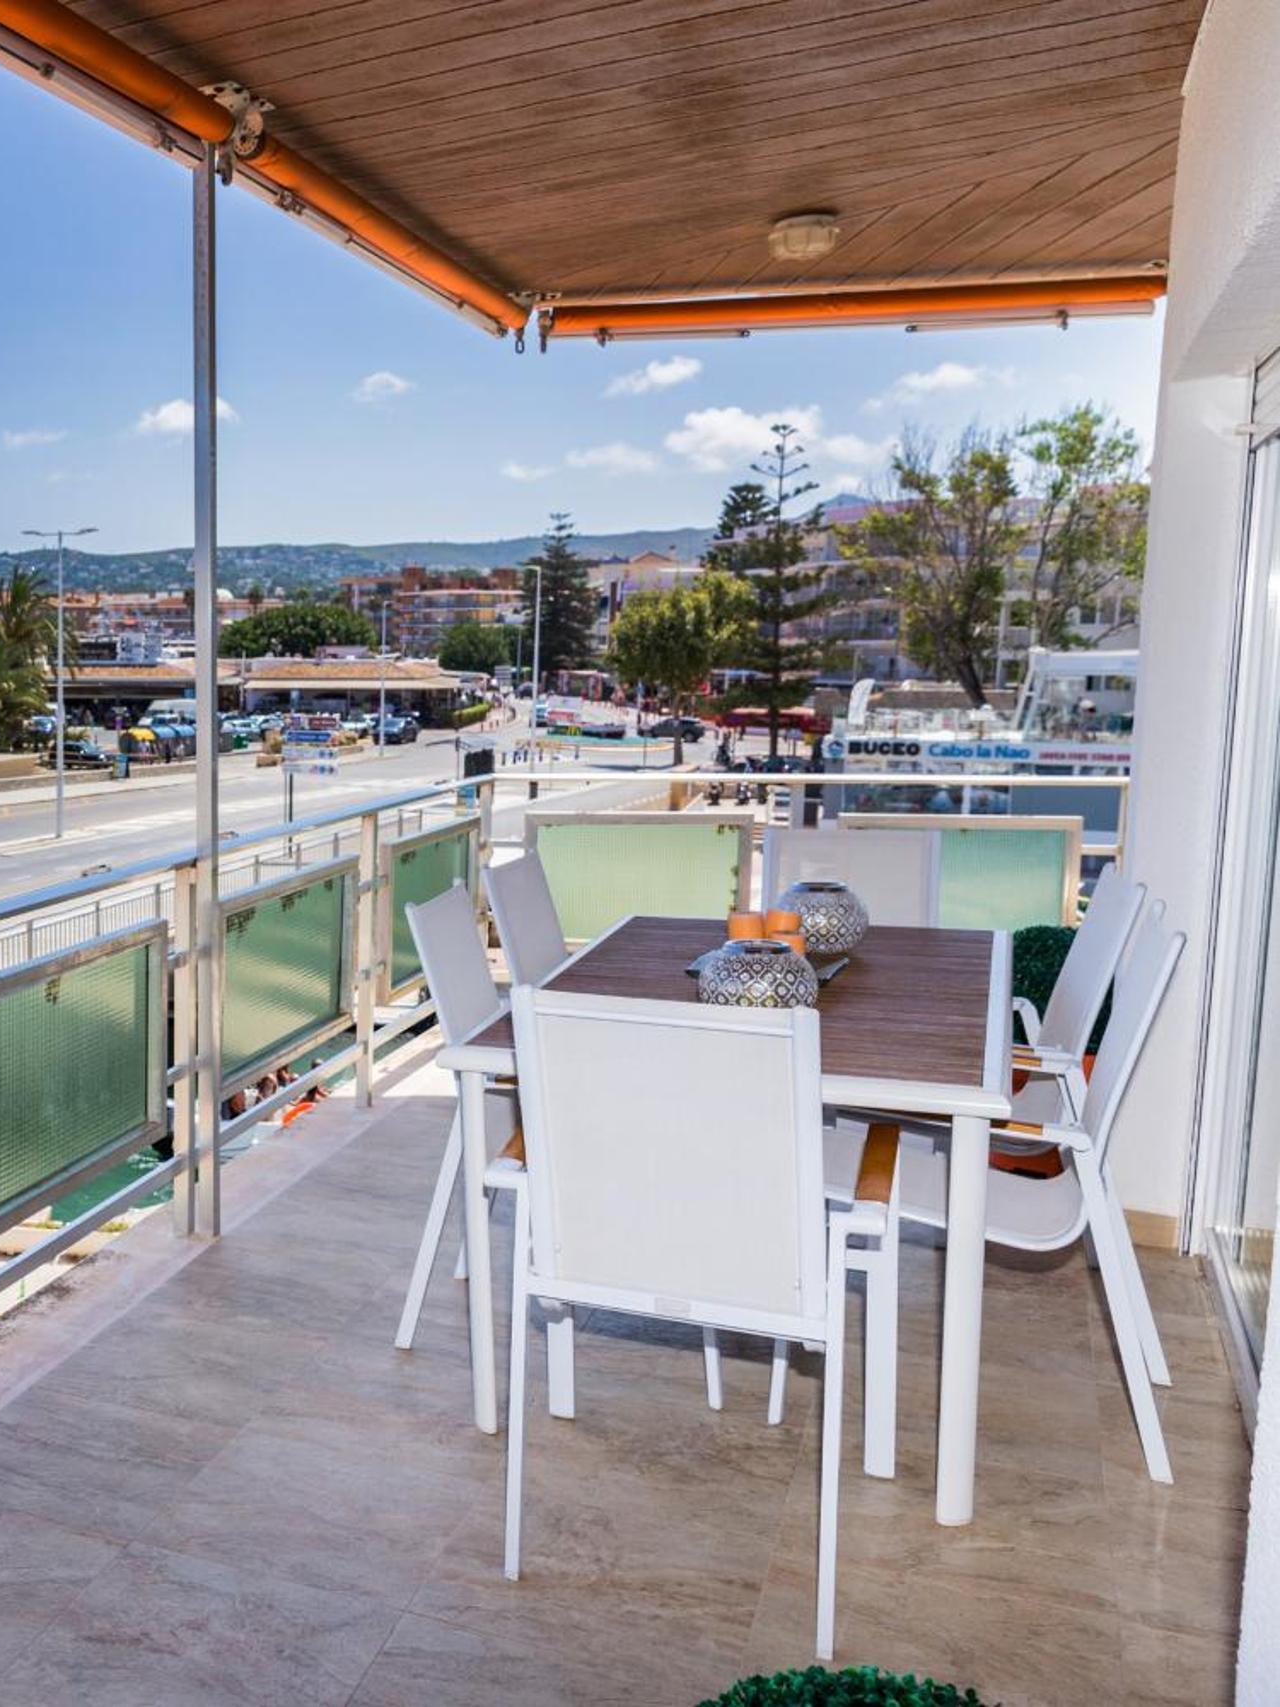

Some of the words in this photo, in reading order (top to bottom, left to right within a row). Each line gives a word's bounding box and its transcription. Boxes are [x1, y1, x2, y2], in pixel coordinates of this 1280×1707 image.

[848, 741, 920, 756] BUCEO
[928, 743, 972, 758] Cabo
[976, 744, 991, 758] la
[995, 745, 1030, 759] Nao
